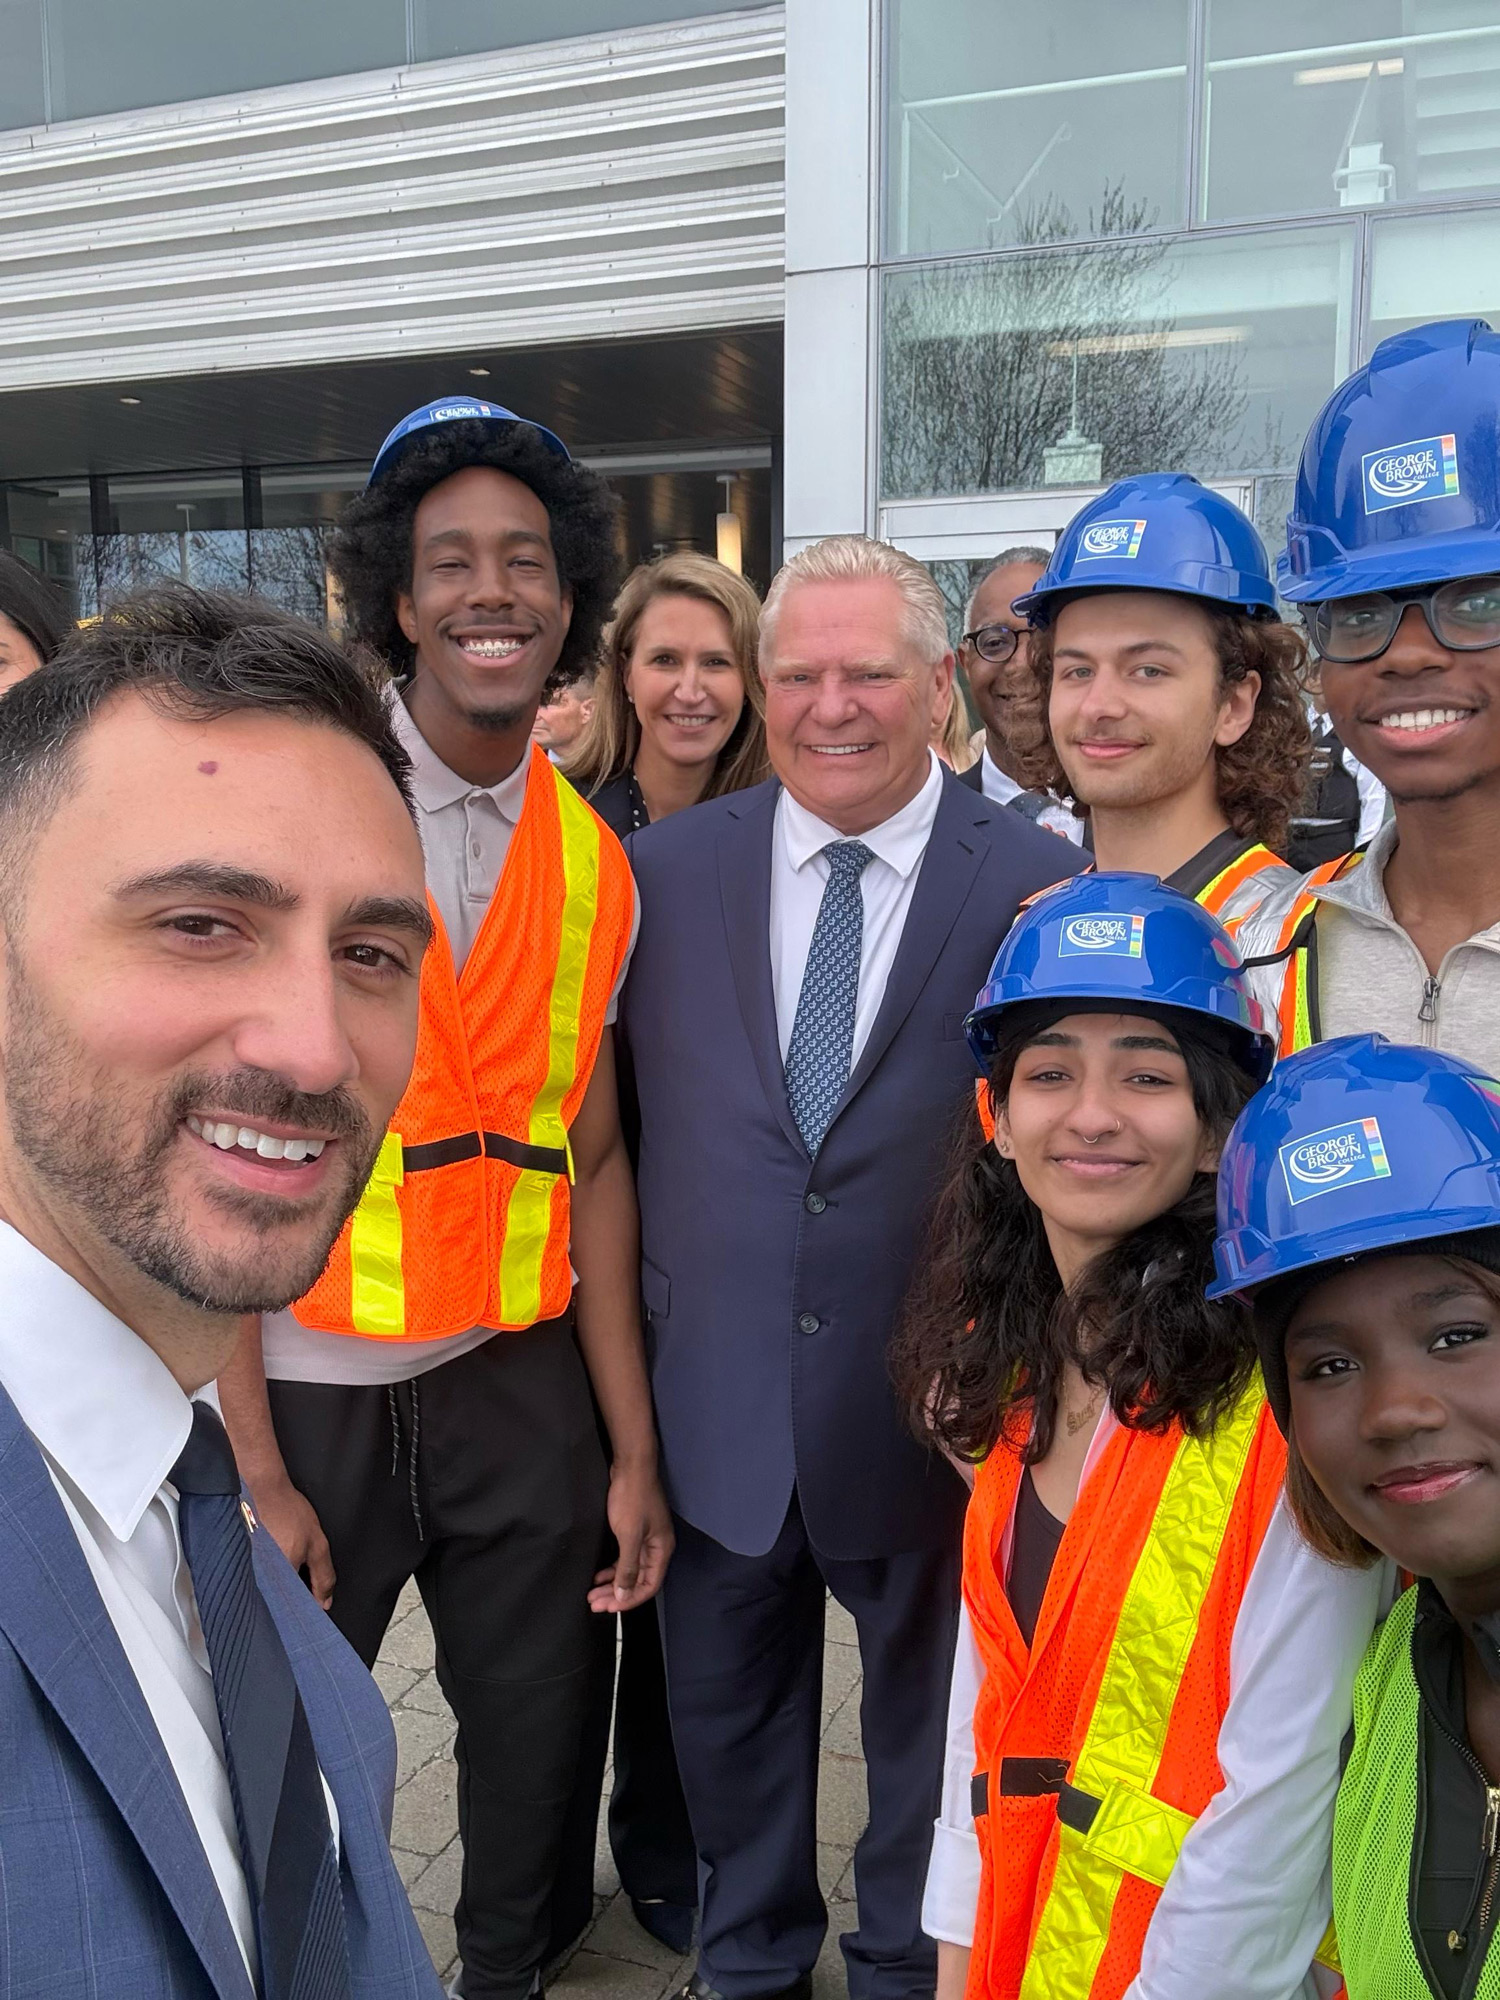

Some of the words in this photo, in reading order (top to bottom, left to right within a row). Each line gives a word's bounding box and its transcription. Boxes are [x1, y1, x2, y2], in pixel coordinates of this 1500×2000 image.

[1378, 450, 1433, 473] GEORGE
[1386, 460, 1436, 482] BROWN
[1413, 471, 1439, 480] COLLEGE
[1091, 526, 1129, 537] GEORGE
[1093, 534, 1129, 543] BROWN
[1075, 920, 1125, 930] GEORGE
[1080, 928, 1126, 937] BROWN
[1298, 1133, 1355, 1160] GEORGE
[1308, 1143, 1361, 1170] BROWN
[1337, 1154, 1366, 1165] COLLEGE
